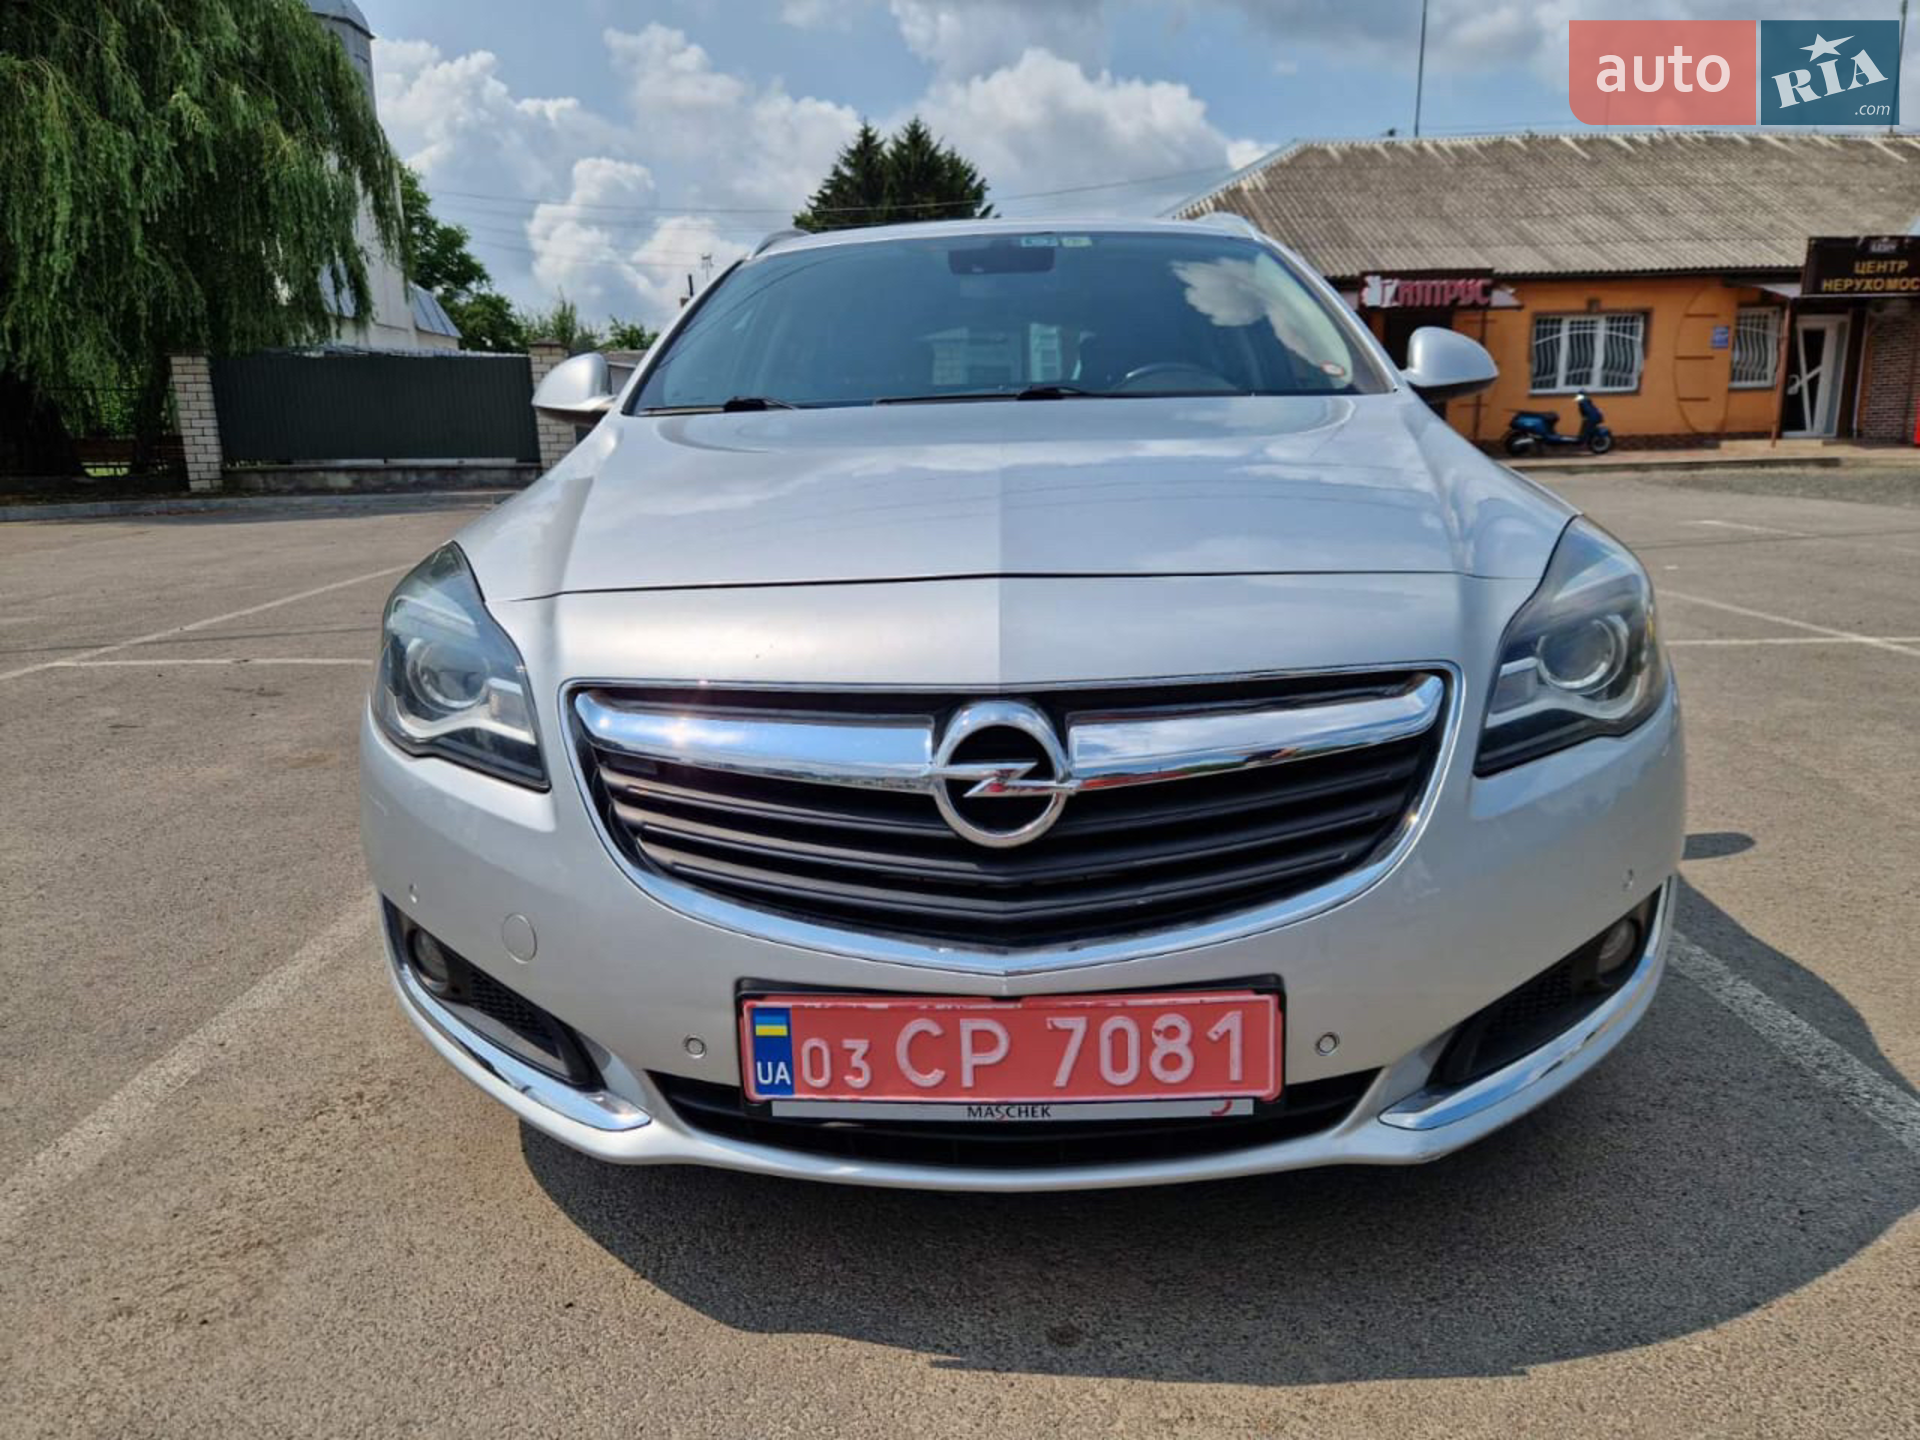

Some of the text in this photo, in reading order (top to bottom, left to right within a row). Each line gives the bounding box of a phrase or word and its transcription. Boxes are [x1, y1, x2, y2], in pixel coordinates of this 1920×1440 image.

[1855, 261, 1908, 275] ЦЕНТР
[801, 1009, 1244, 1088] 03 CP 7081
[756, 1061, 792, 1085] UA
[967, 1102, 1052, 1120] MASCHEK
